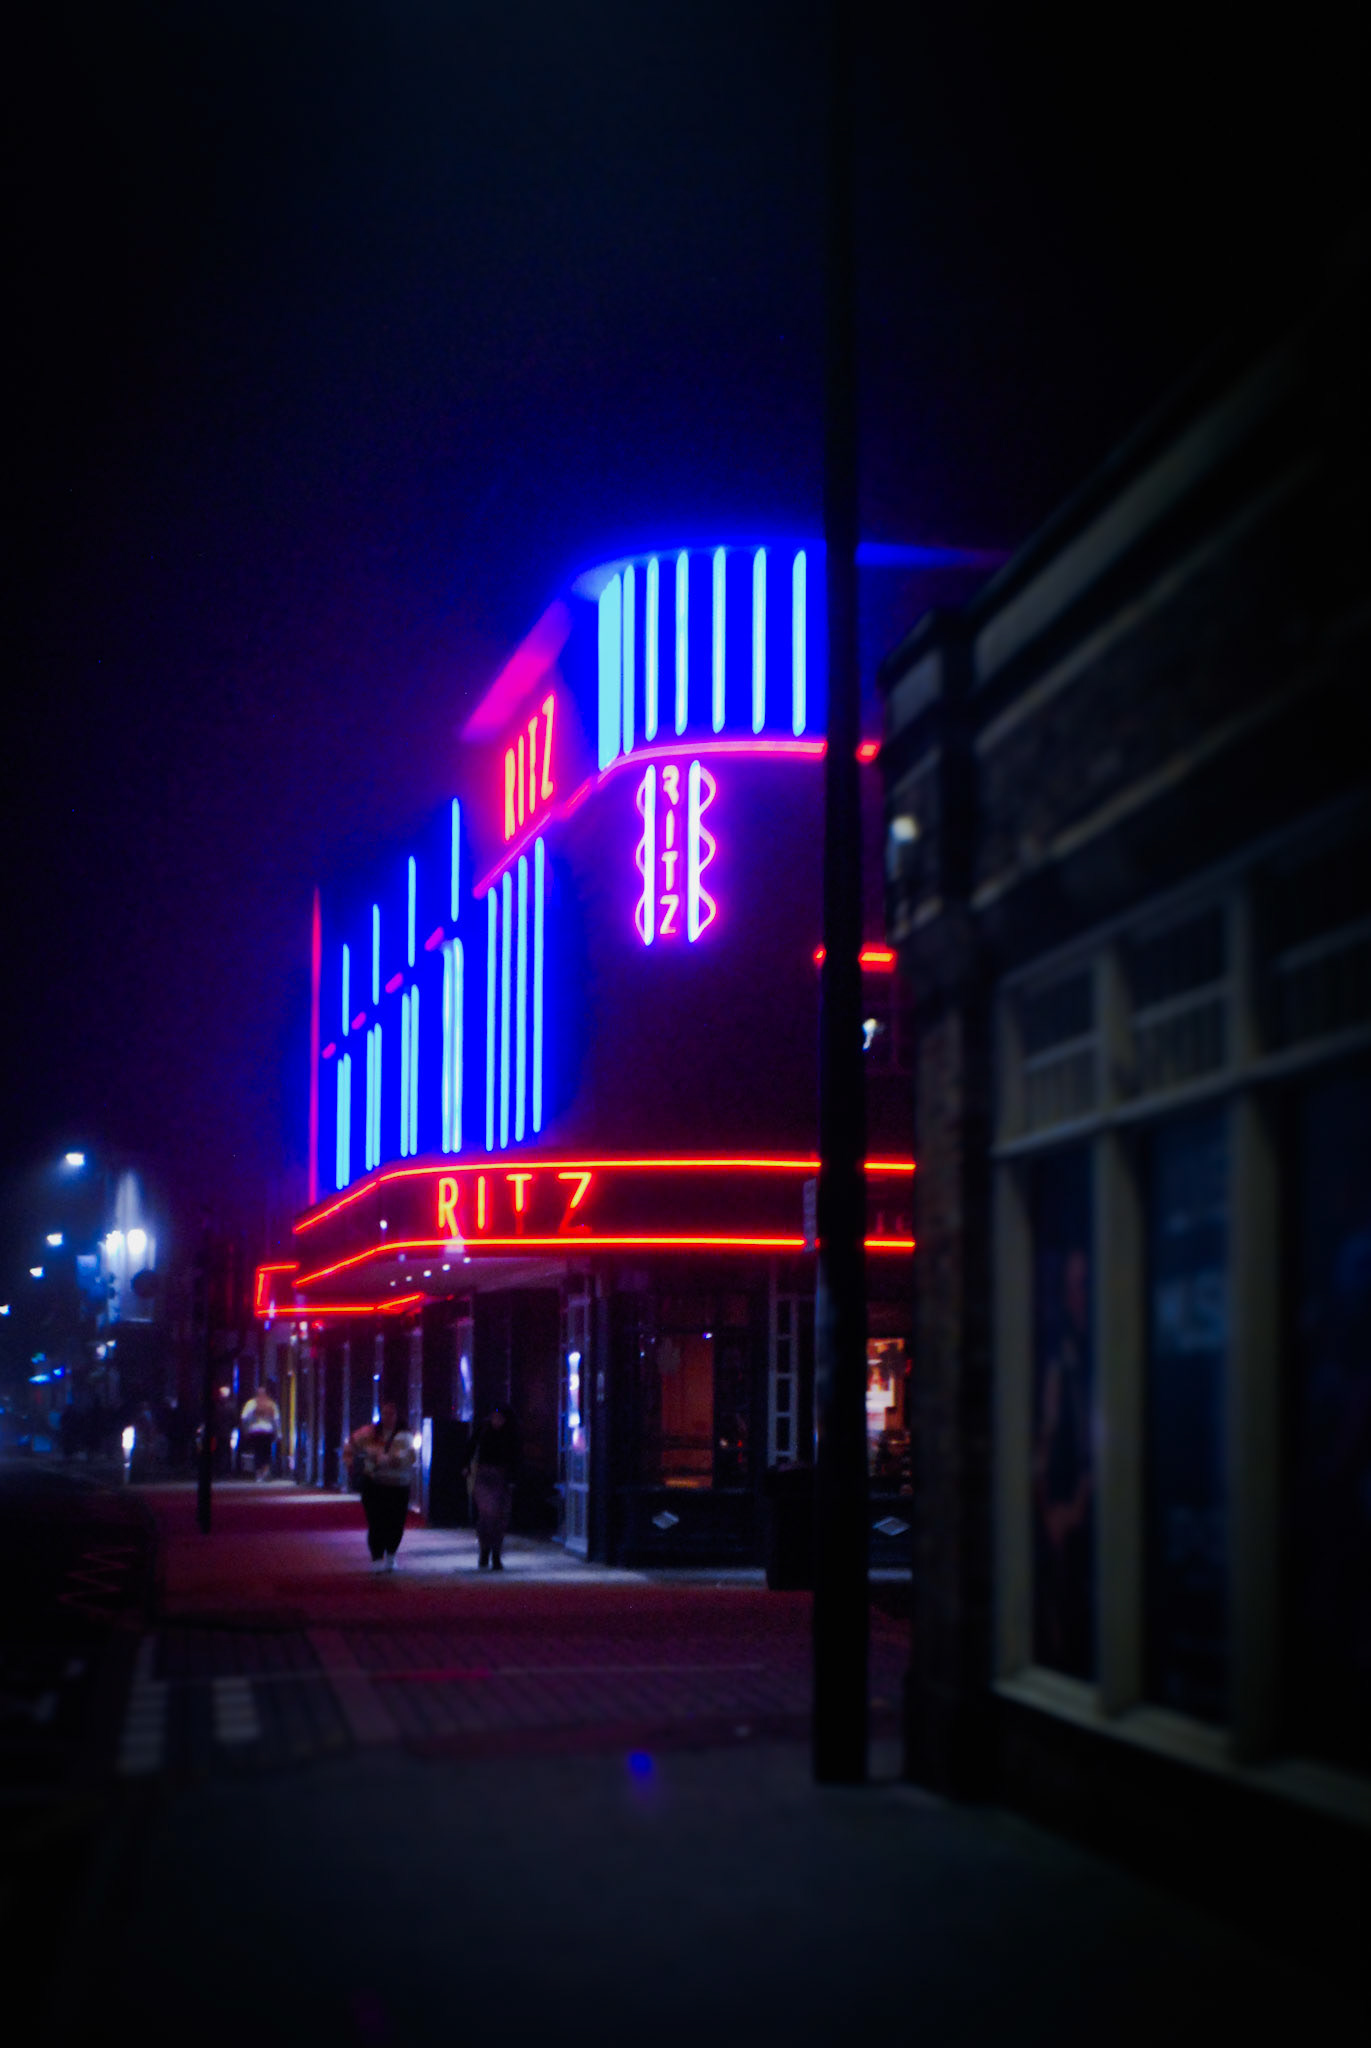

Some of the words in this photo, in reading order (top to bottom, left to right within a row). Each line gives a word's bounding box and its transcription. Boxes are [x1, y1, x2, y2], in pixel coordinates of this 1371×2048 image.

[505, 695, 554, 841] RITZ
[660, 765, 679, 934] RITZ
[438, 1172, 592, 1236] RITZ
